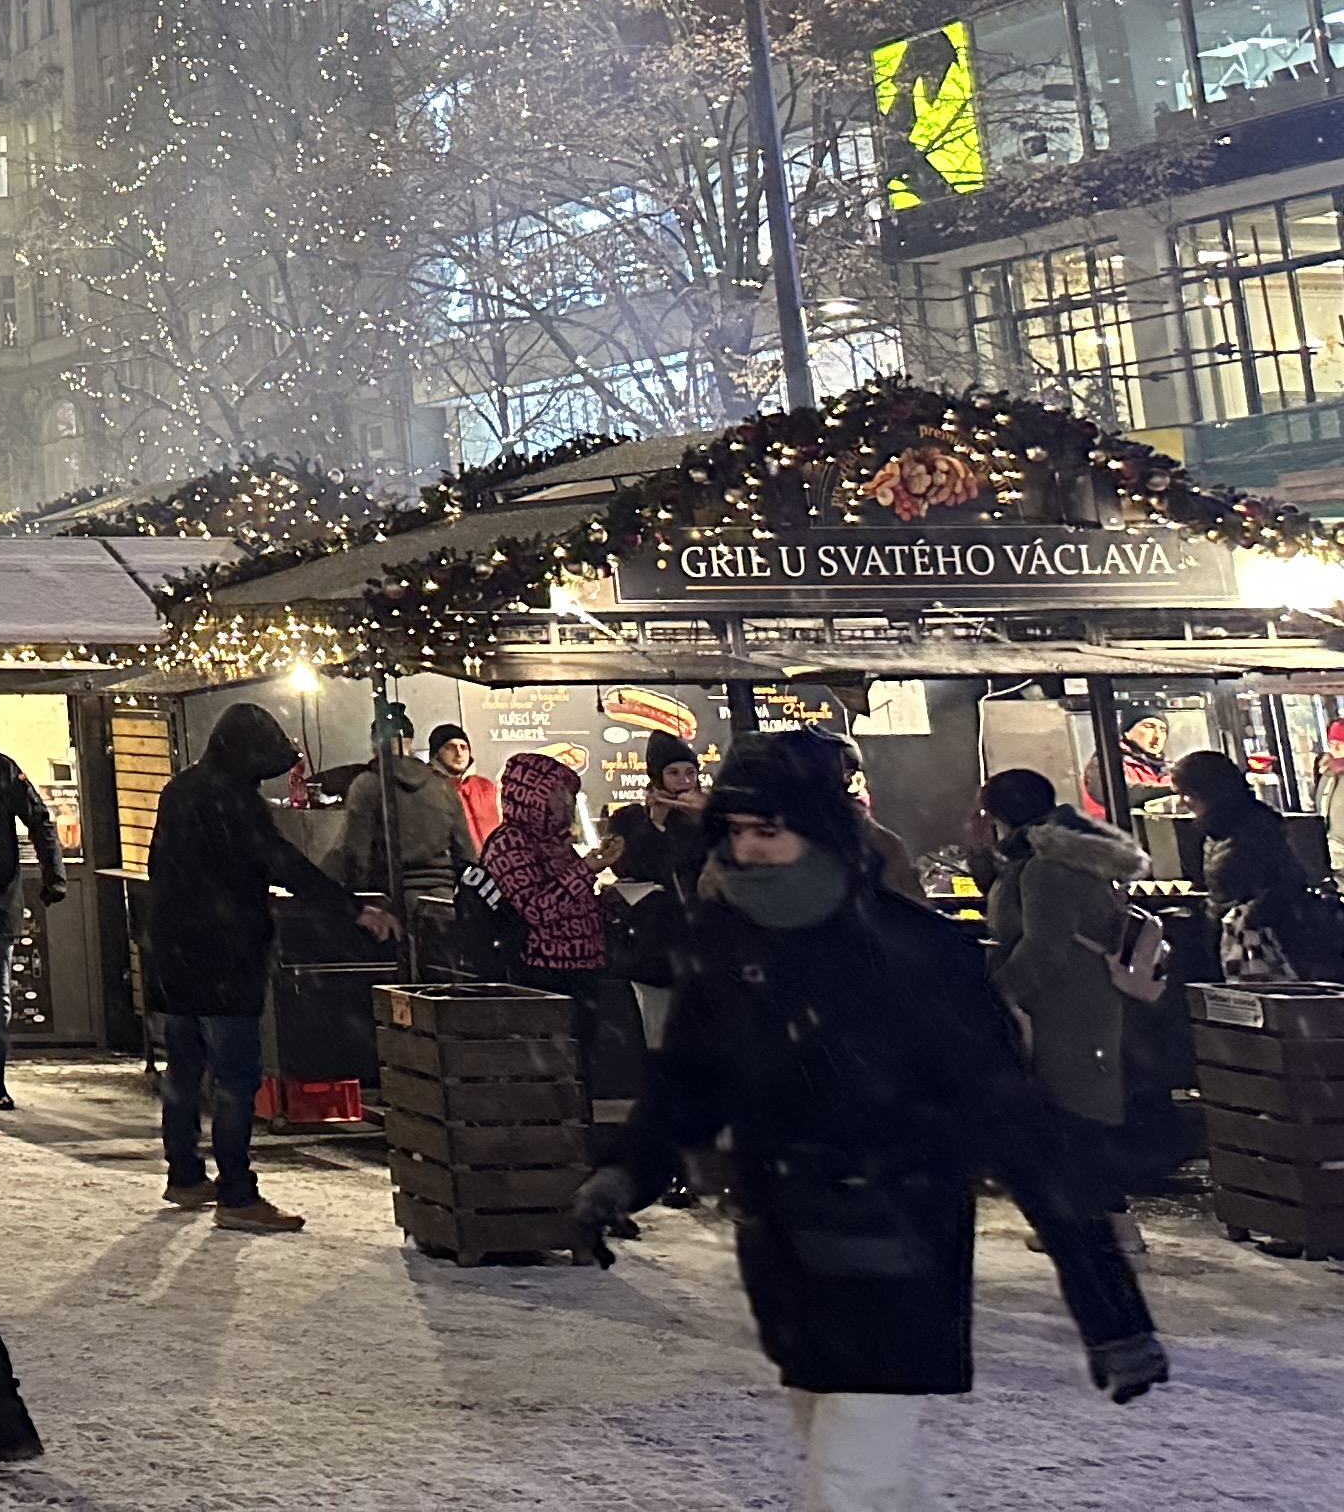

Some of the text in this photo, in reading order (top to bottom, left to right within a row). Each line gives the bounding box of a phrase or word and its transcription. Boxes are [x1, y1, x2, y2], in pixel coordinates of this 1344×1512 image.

[778, 545, 806, 578] U
[819, 538, 996, 577] SVATÉHO
[1003, 538, 1176, 577] VÁCLAVA
